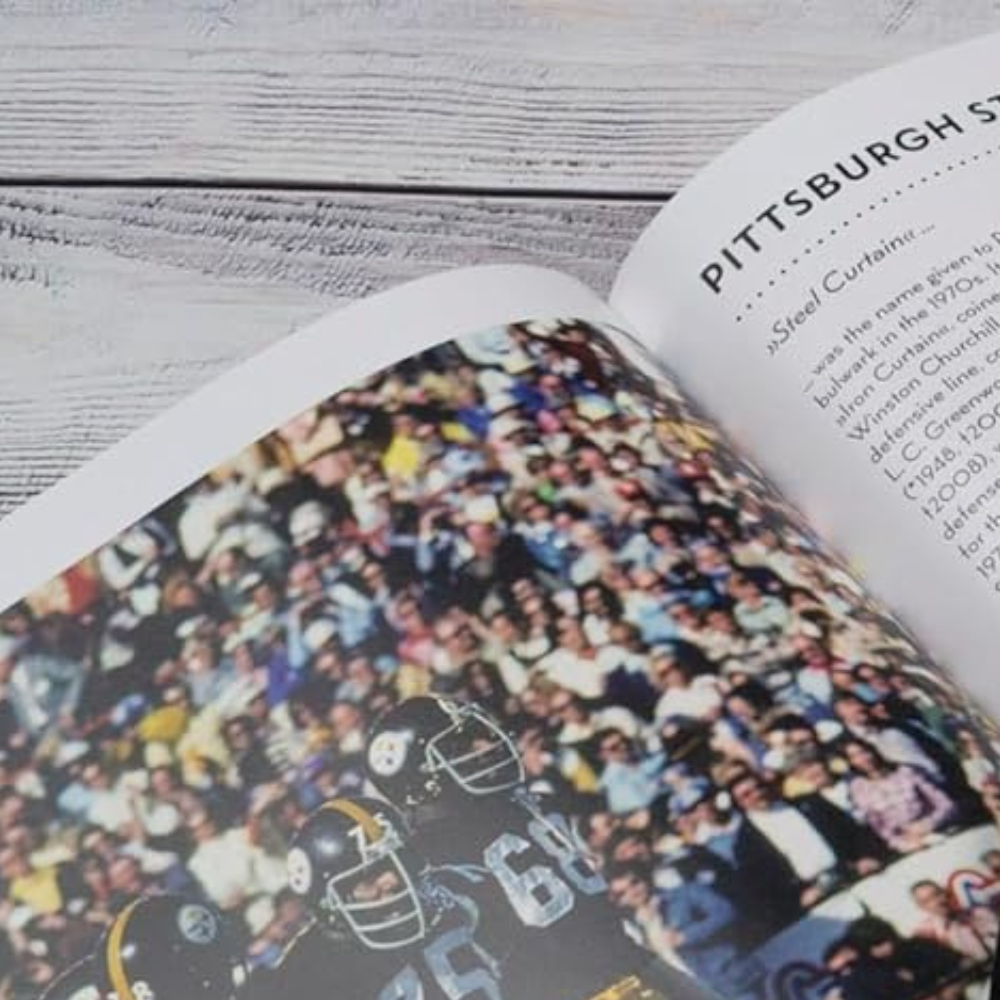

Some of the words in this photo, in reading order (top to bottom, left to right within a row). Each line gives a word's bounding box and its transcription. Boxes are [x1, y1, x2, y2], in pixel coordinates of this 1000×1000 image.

[700, 113, 964, 294] PITTSBURGH
[812, 346, 844, 375] was
[843, 320, 872, 344] the
[875, 283, 924, 320] name
[926, 255, 973, 287] given
[813, 347, 878, 409] bulwark
[898, 309, 928, 332] the
[846, 378, 921, 440] Winston
[920, 316, 1000, 376] Churchill
[870, 392, 944, 464] defensive
[958, 533, 984, 559] for
